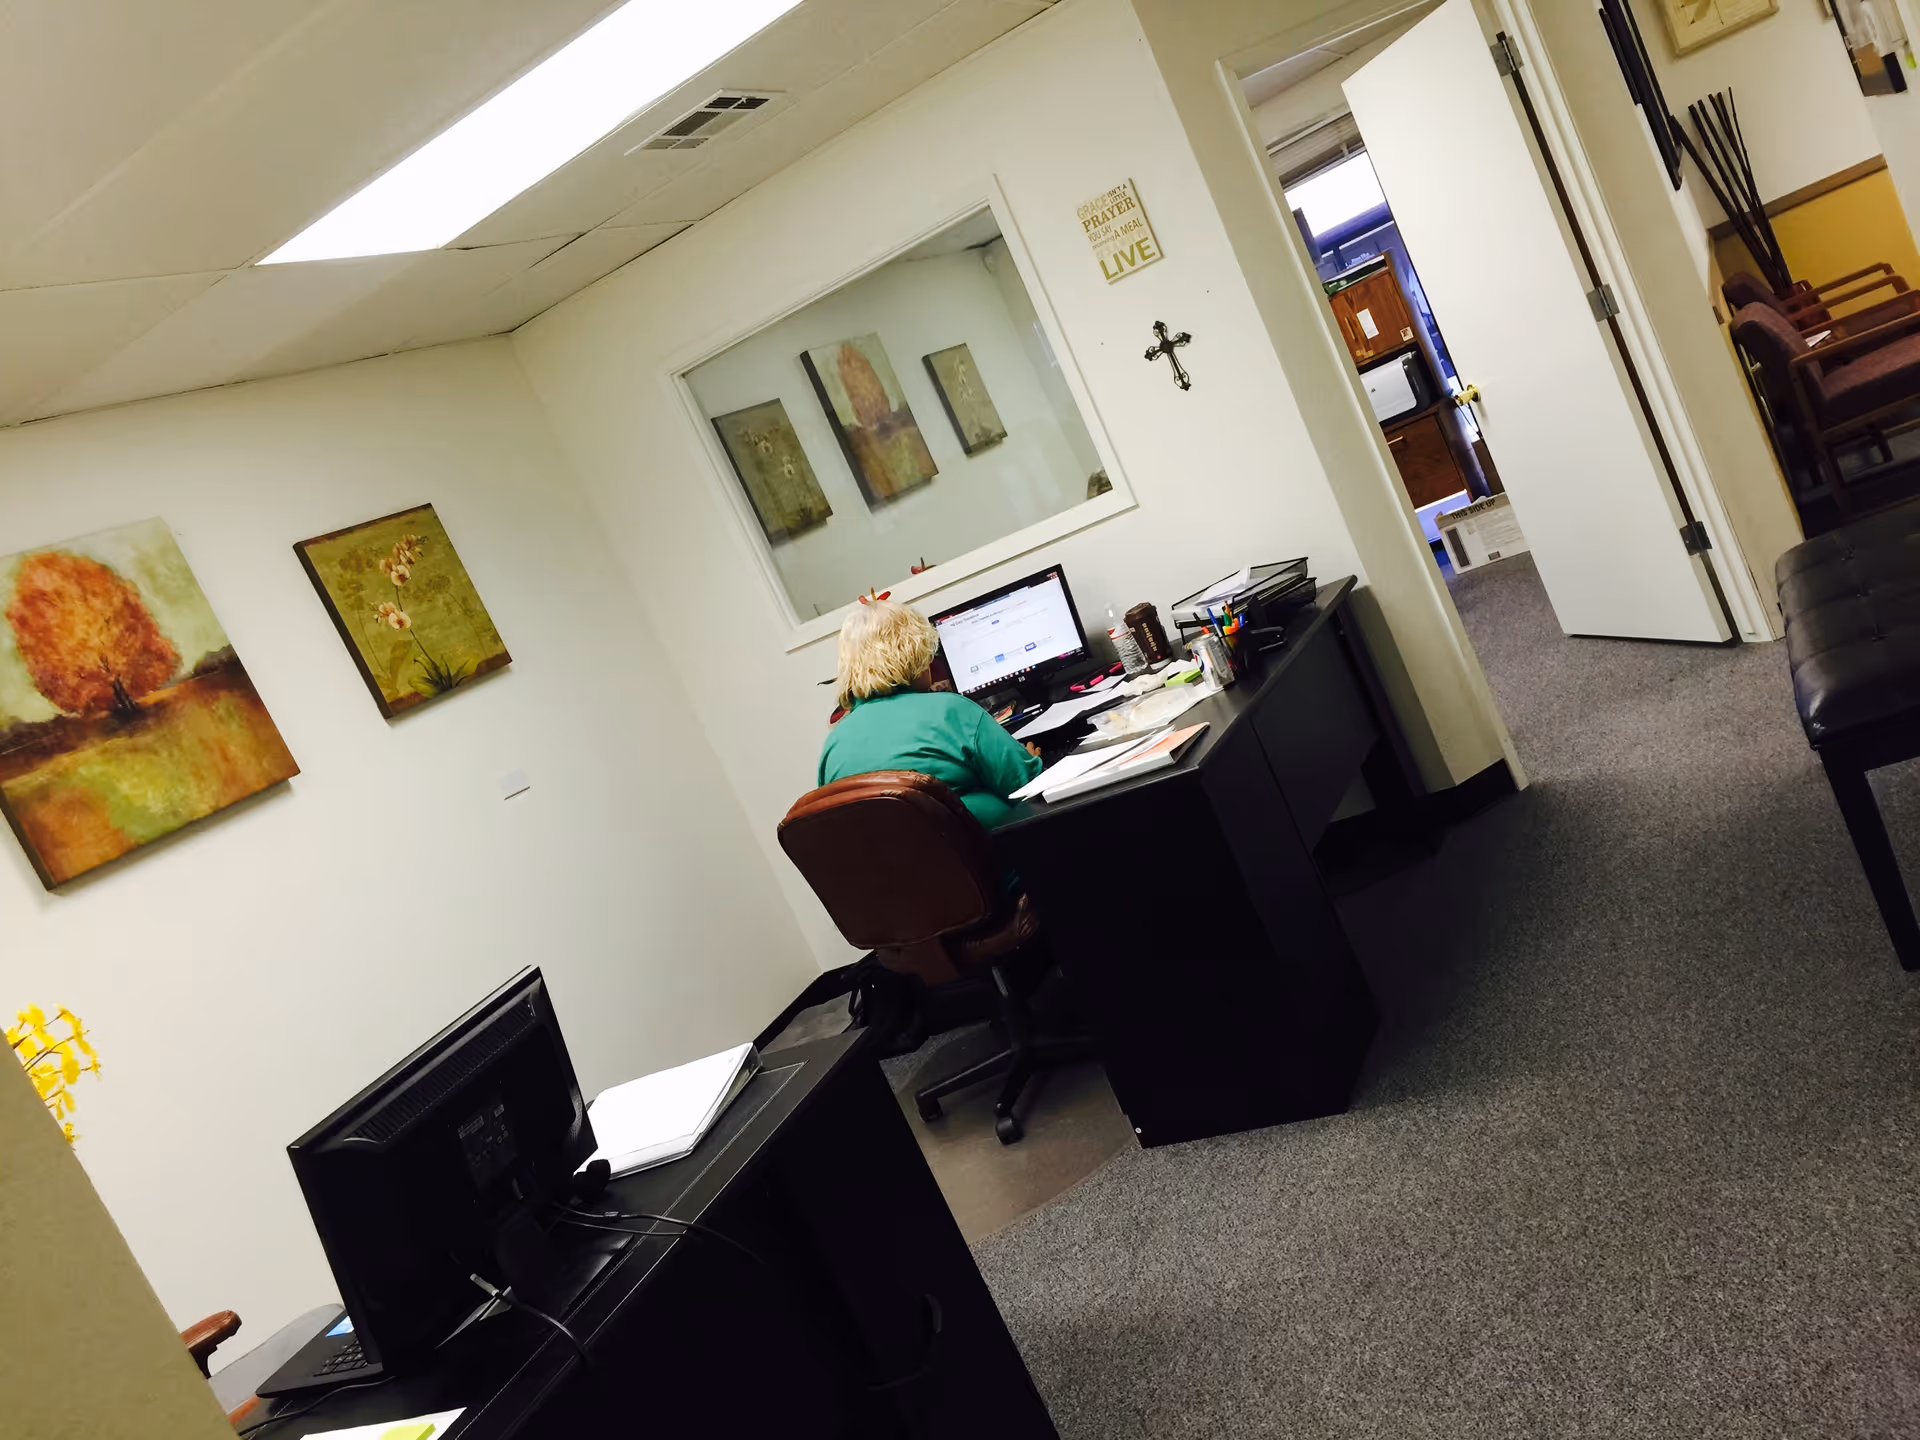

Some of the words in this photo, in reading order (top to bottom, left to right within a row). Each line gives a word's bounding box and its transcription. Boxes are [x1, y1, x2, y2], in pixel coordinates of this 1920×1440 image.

[1077, 194, 1110, 220] GRACE
[1109, 191, 1127, 203] LITTLE
[1082, 196, 1136, 233] PRAYER
[1088, 230, 1102, 242] YOU
[1101, 224, 1112, 237] SAY
[1113, 229, 1121, 240] A
[1120, 217, 1143, 236] MEAL
[1099, 236, 1156, 280] LIVE
[1451, 509, 1468, 520] THIS
[1468, 503, 1486, 515] SIDE
[1486, 498, 1496, 508] UP
